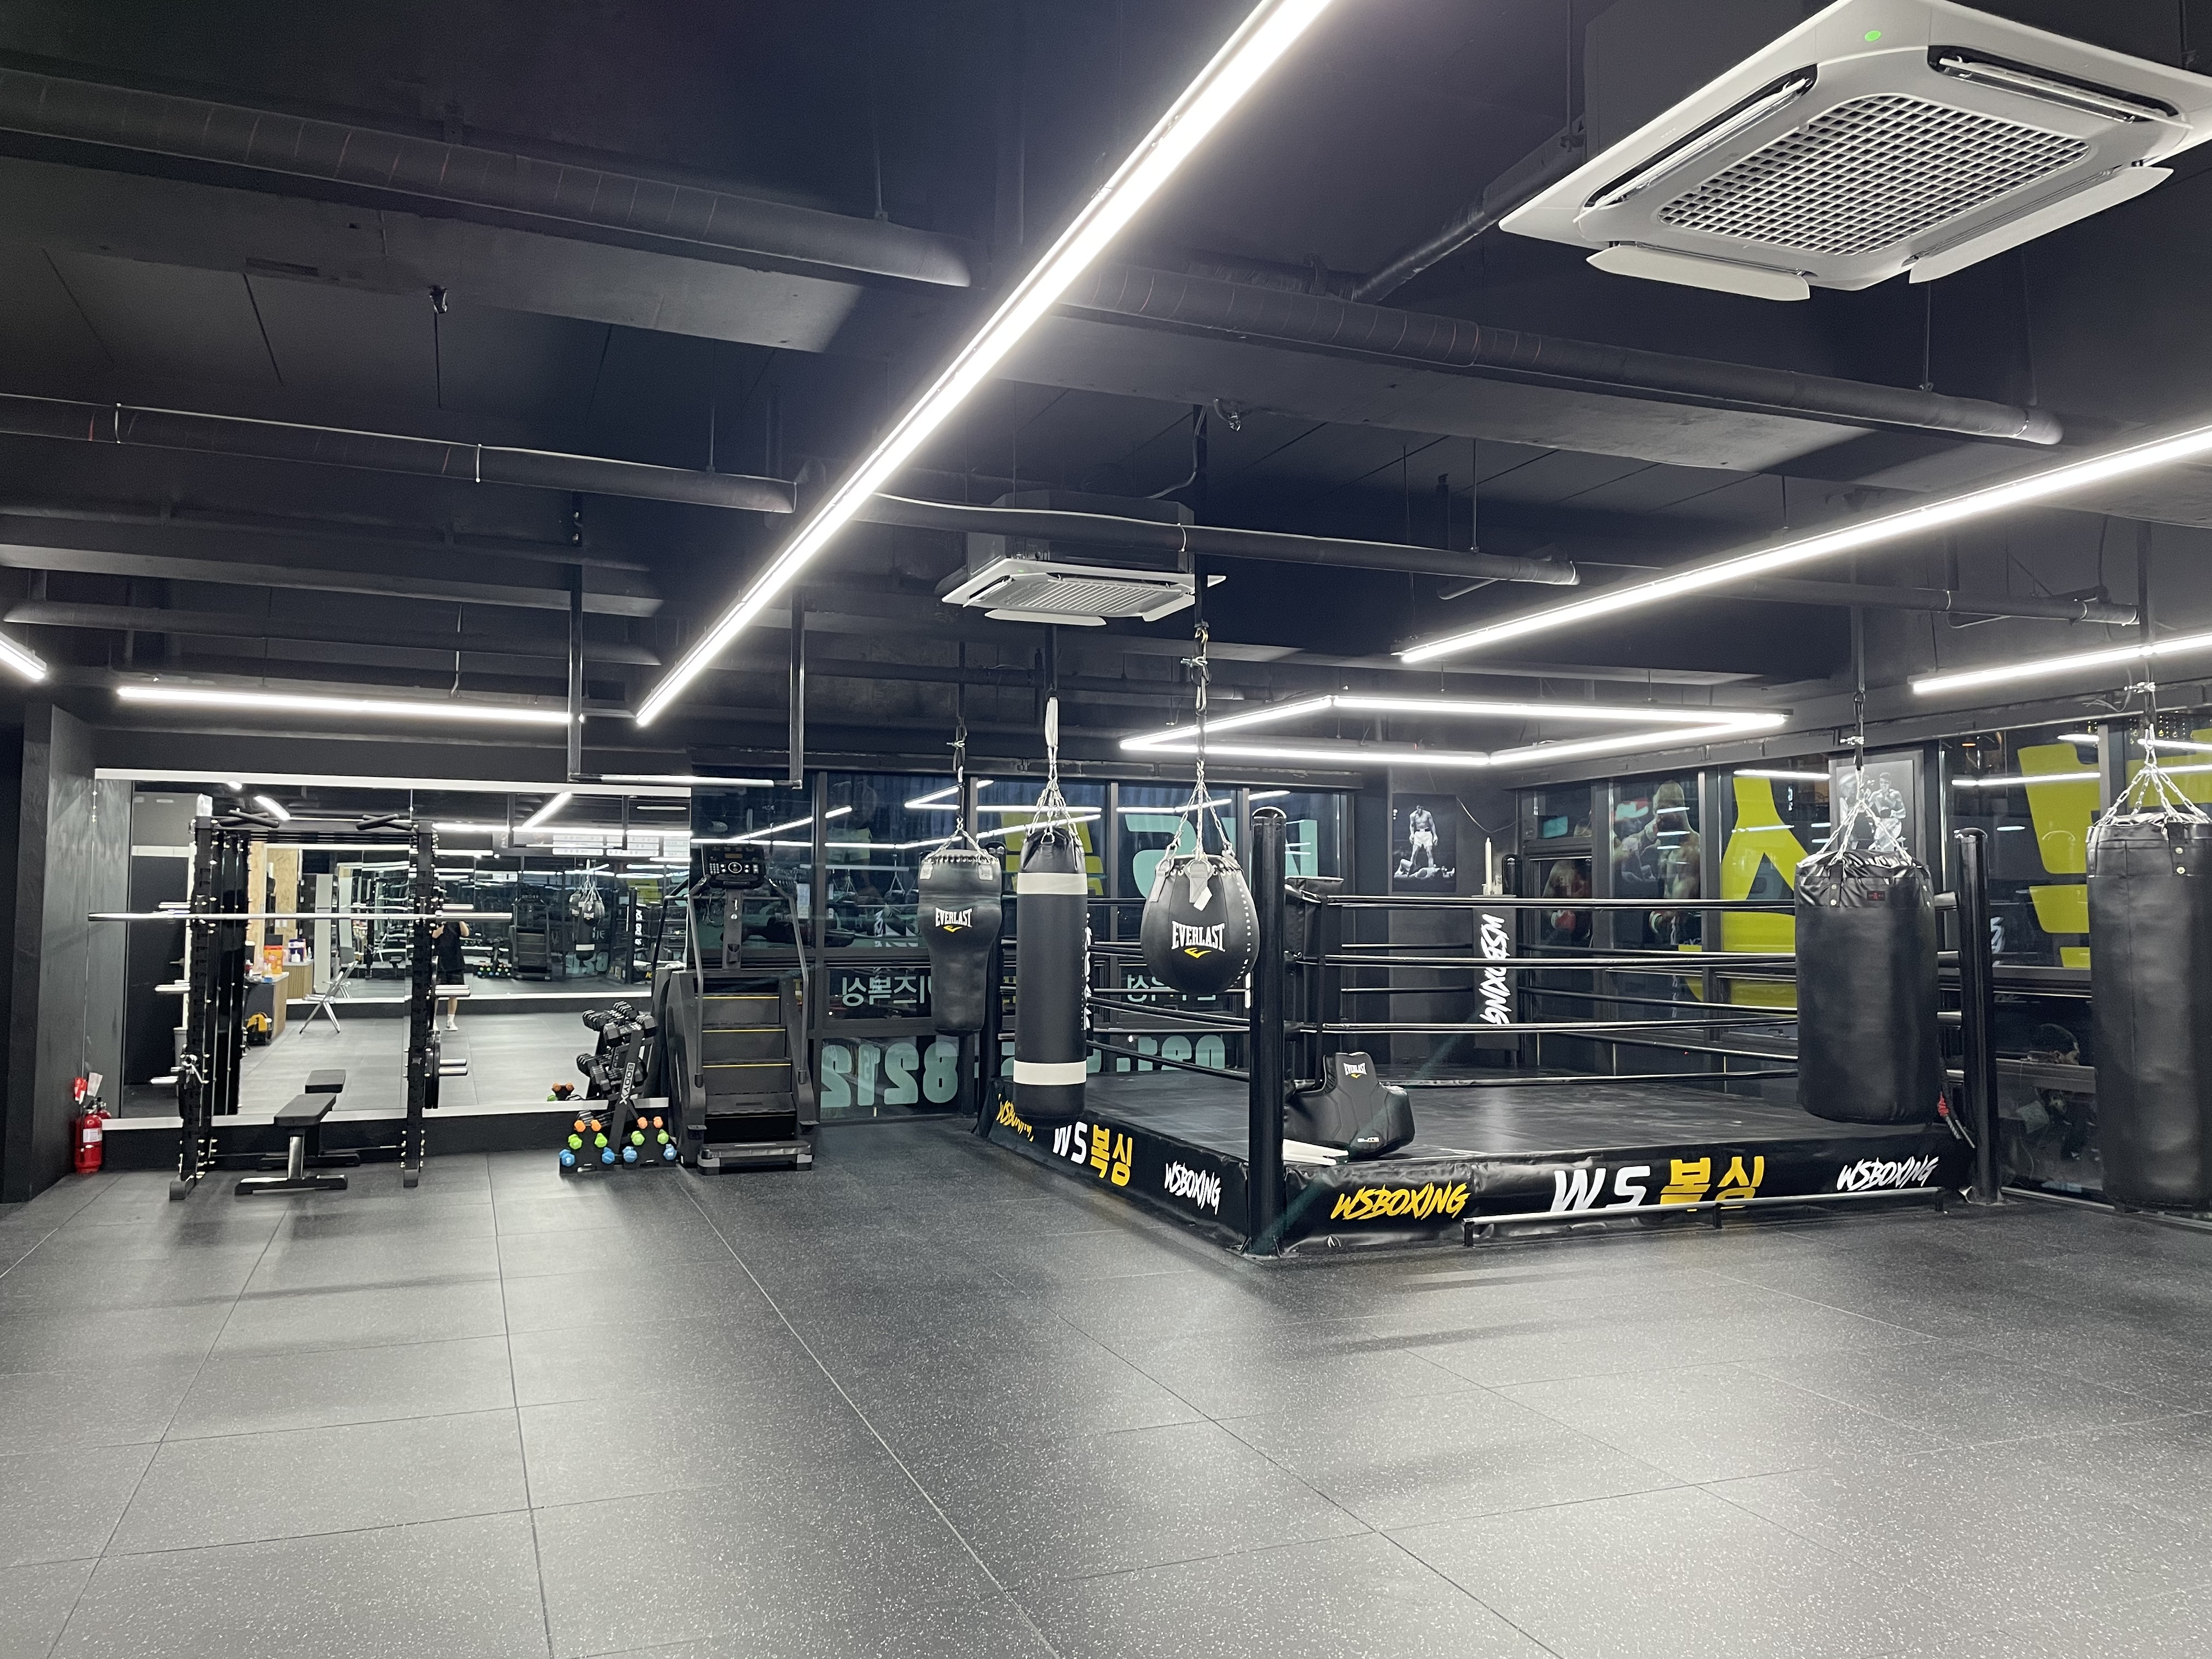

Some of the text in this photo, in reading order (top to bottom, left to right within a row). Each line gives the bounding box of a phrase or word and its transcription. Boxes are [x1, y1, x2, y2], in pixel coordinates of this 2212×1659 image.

[935, 907, 973, 928] EVERLAST
[1171, 921, 1226, 952] EVERLAST
[1164, 1160, 1222, 1215] WSBOXING
[1837, 1154, 1940, 1192] WSBOXING
[1330, 1180, 1471, 1220] WSBOXING
